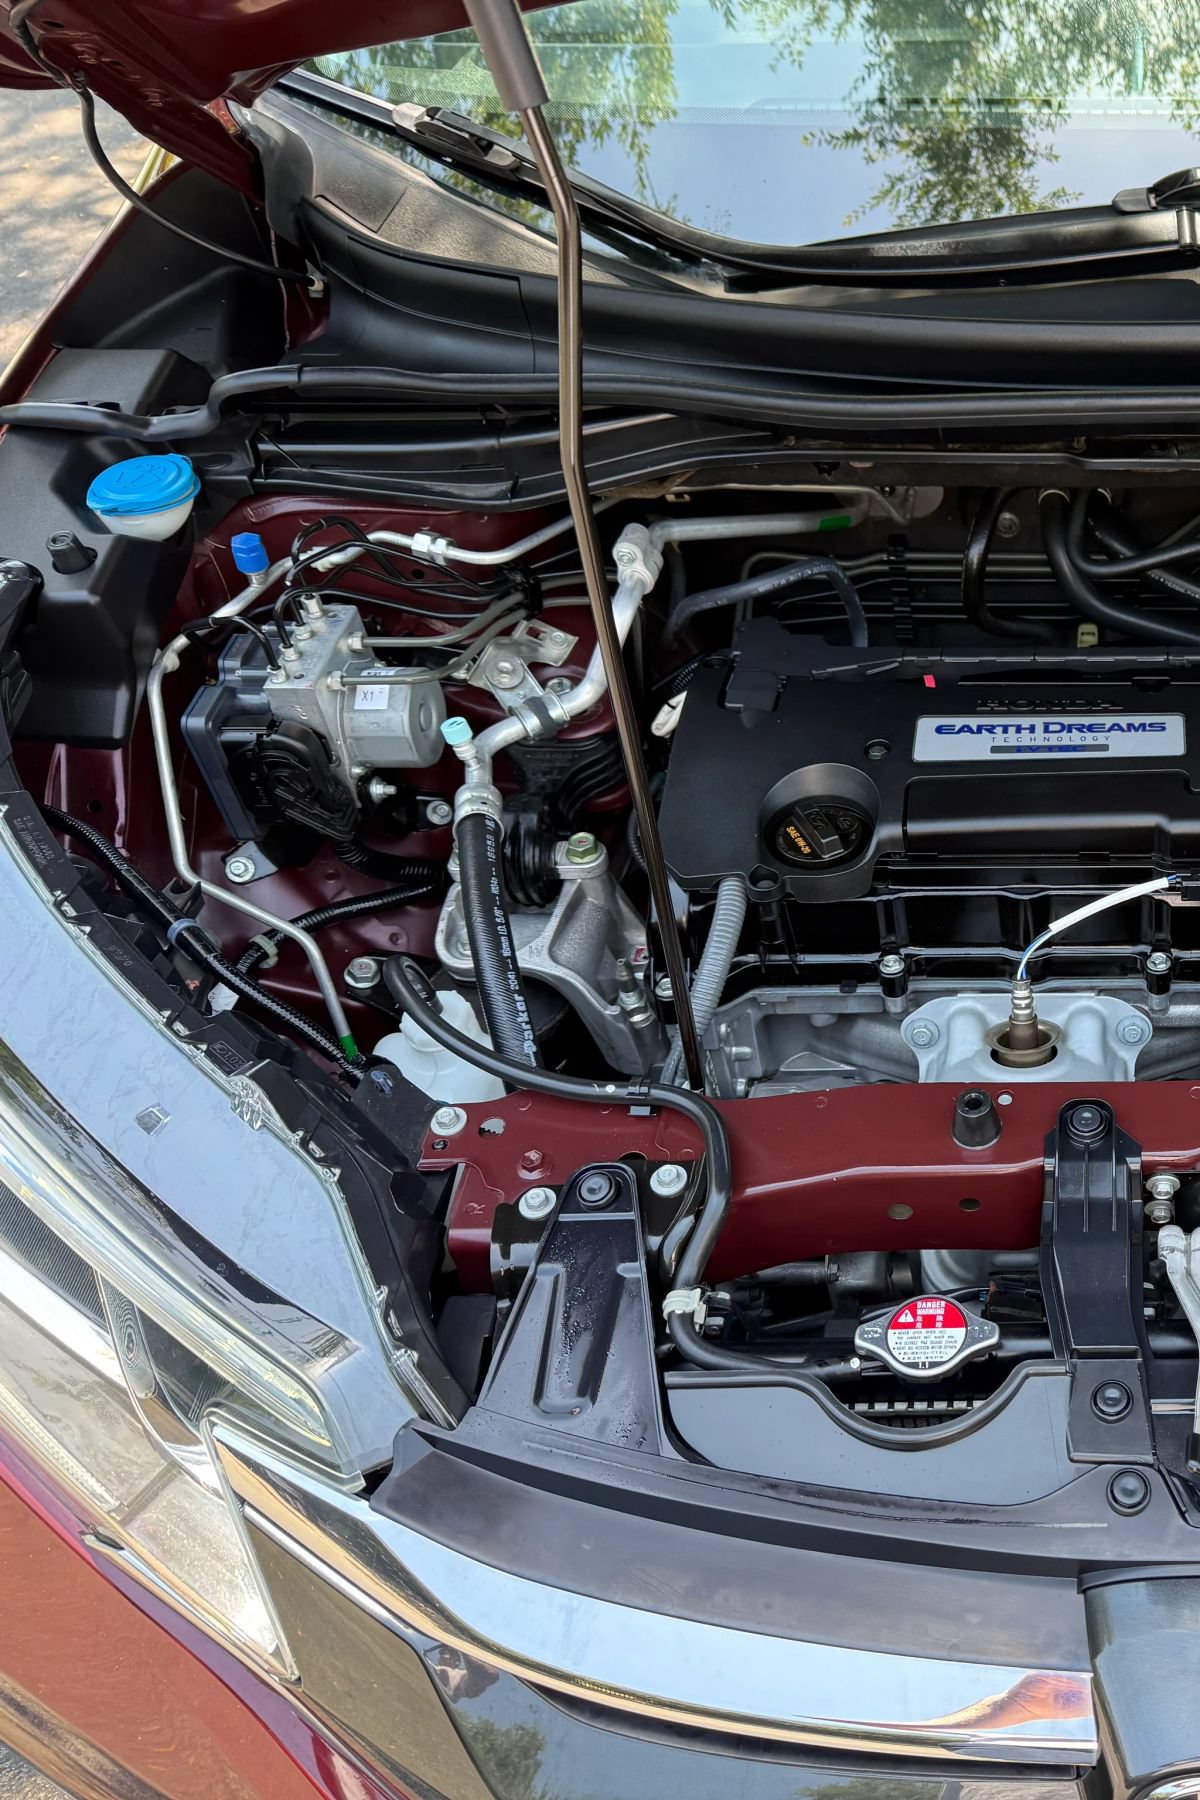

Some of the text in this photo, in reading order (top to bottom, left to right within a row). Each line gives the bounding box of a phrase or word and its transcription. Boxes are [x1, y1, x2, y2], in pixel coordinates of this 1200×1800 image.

[934, 721, 1167, 735] EARTH DREAMS
[991, 735, 1111, 743] TECHNOLOGY
[786, 826, 812, 854] SAE 0W-20
[500, 936, 512, 958] 16mm
[507, 971, 520, 991] 2041
[916, 1300, 946, 1309] DANGER
